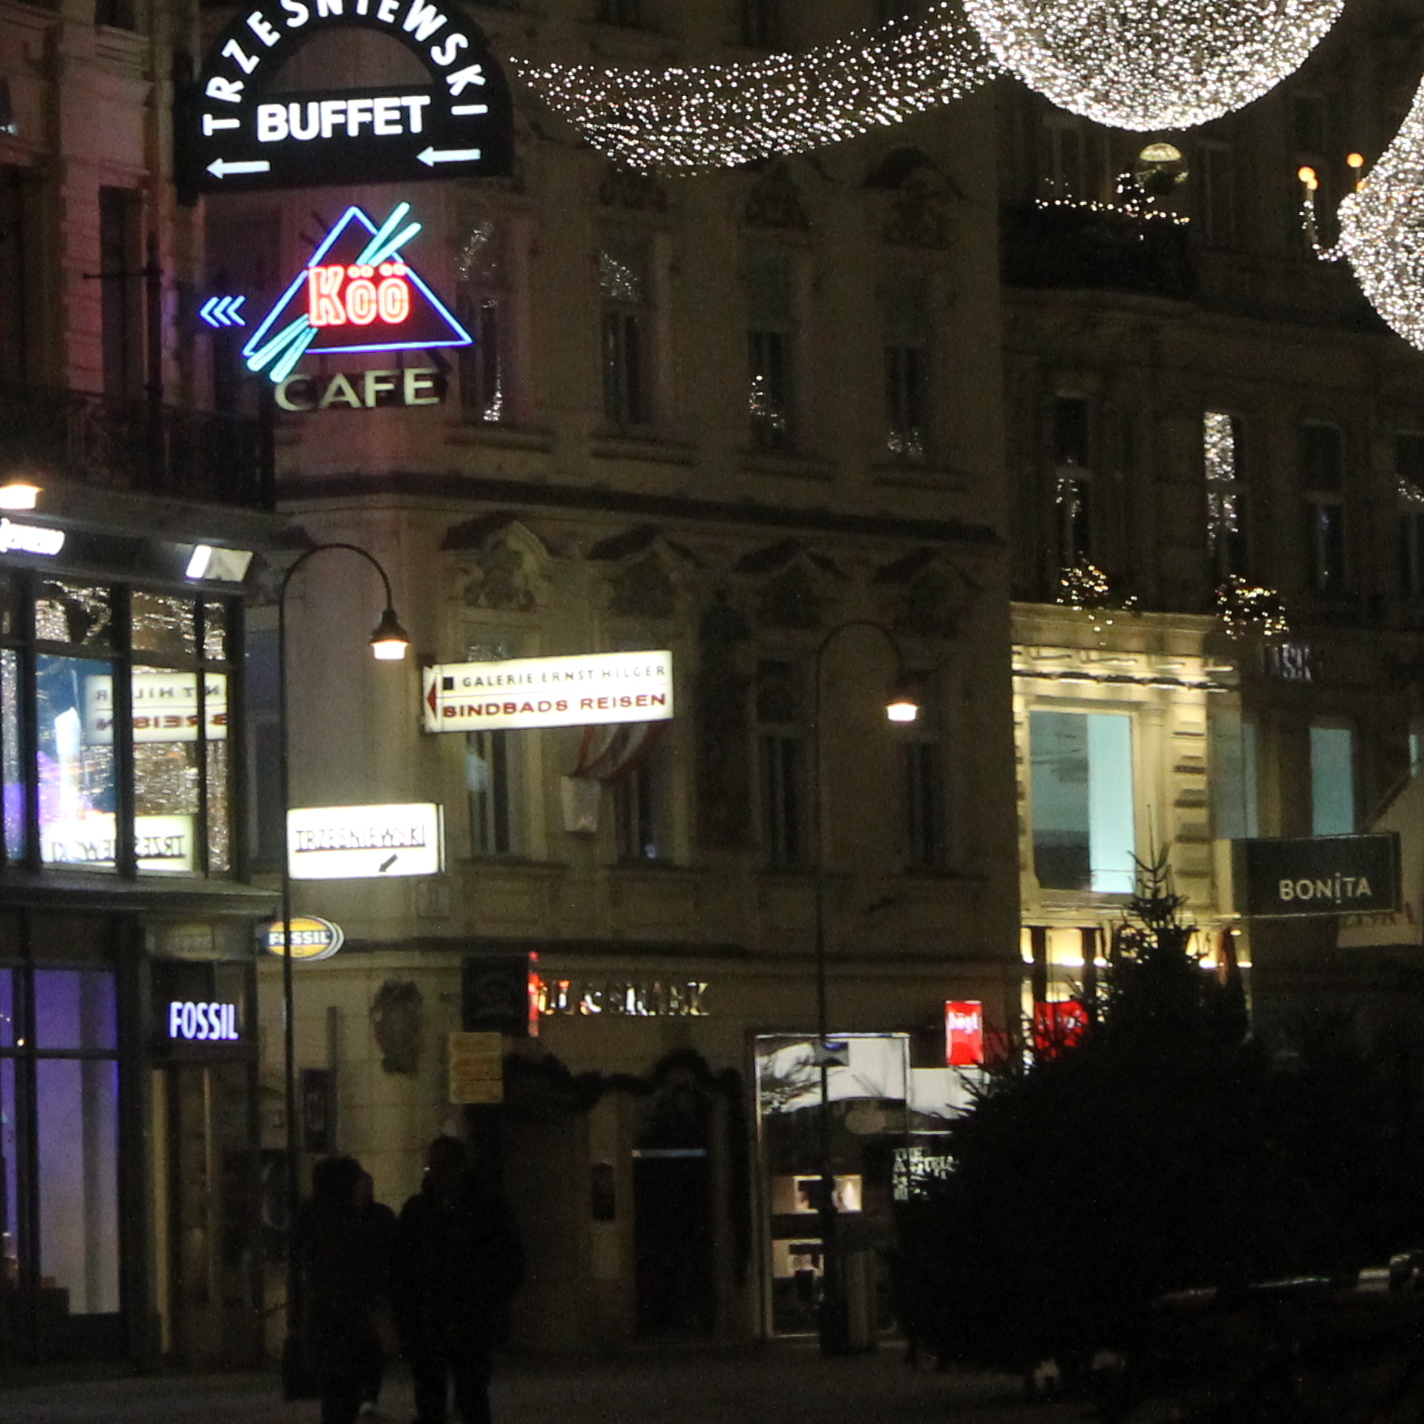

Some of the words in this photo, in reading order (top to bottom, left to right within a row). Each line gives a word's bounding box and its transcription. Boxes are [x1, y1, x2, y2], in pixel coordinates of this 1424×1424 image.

[257, 95, 431, 143] BUFFET
[273, 366, 441, 412] CAFE
[462, 672, 533, 688] GALERIE
[541, 669, 594, 683] ERNST
[601, 665, 667, 679] HILGER
[442, 699, 569, 718] SINDBADS
[579, 692, 667, 711] REISEN
[169, 1000, 240, 1041] FOSSIL
